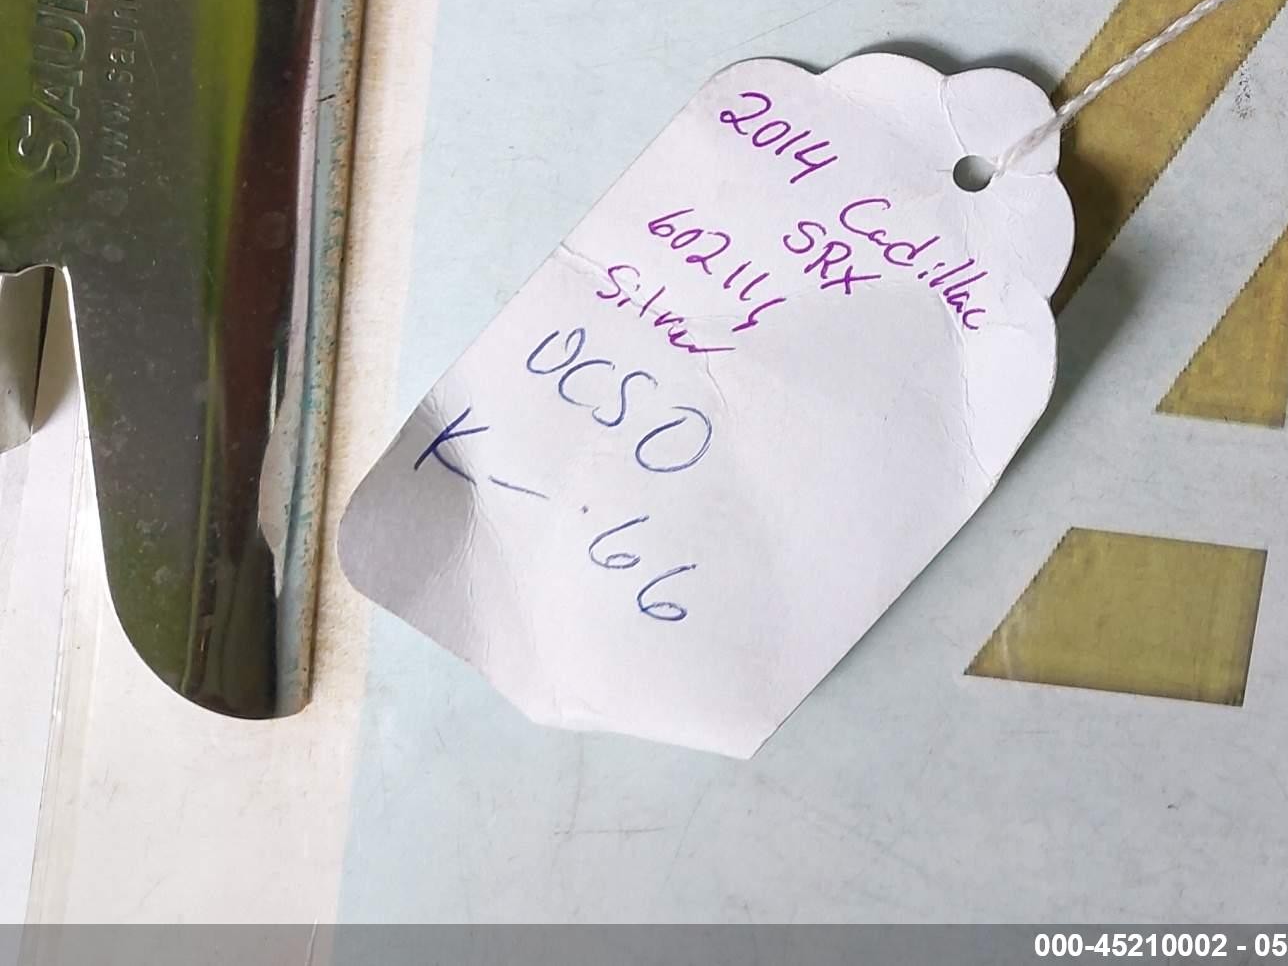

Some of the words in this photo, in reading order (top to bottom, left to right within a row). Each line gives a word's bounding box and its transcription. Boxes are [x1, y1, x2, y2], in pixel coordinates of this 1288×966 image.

[719, 91, 838, 184] 2014
[839, 197, 988, 331] Cadillac
[783, 221, 882, 294] SRX
[596, 265, 735, 353] Silver
